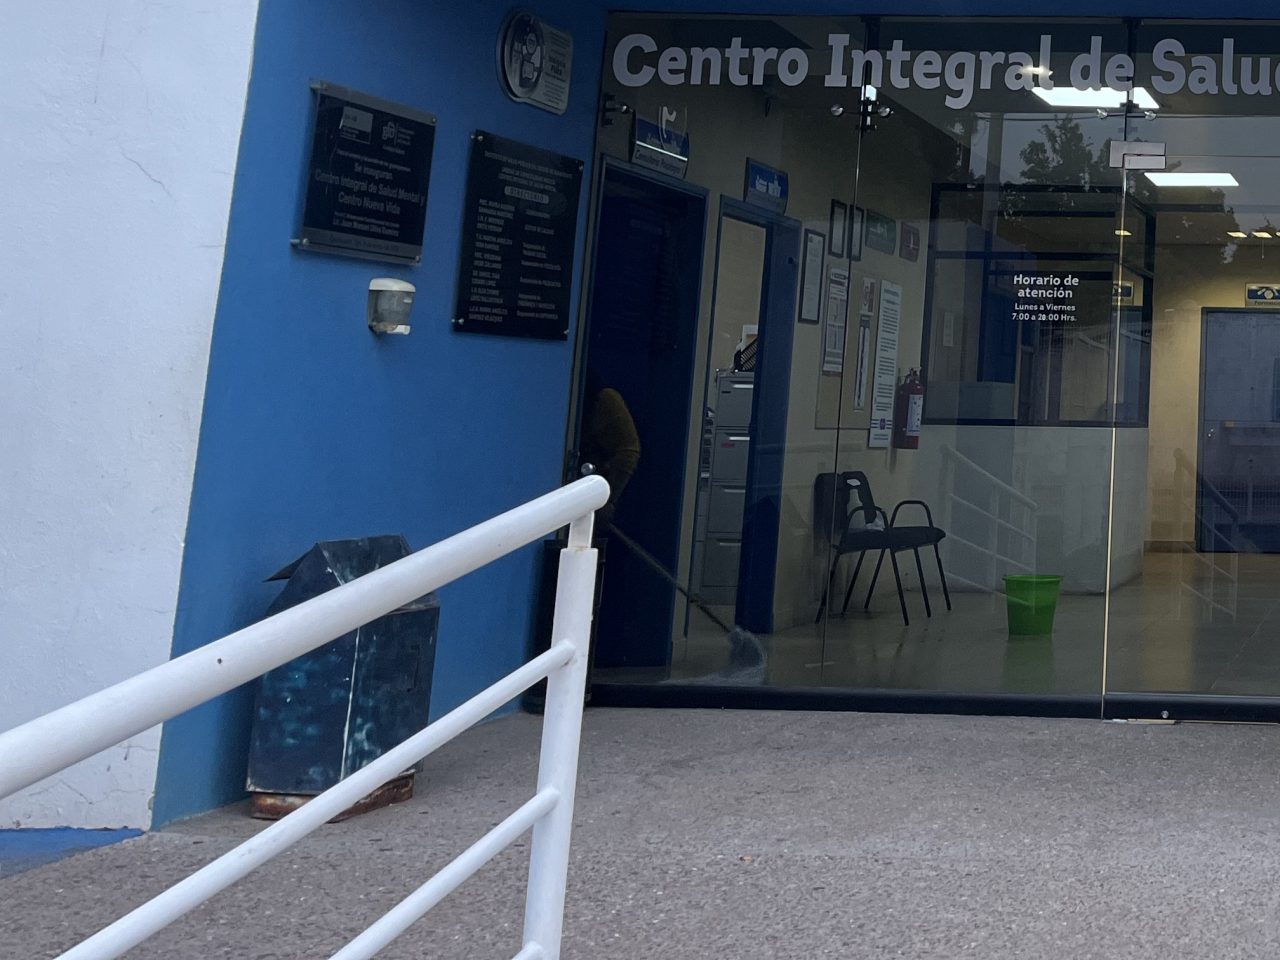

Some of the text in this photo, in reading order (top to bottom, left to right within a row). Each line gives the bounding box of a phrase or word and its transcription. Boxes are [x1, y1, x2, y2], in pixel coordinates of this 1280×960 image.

[612, 33, 809, 87] Centro
[824, 33, 1054, 110] Integral
[1069, 35, 1135, 91] de
[1013, 274, 1080, 286] Horario de
[1018, 287, 1073, 298] atención
[1046, 303, 1076, 311] Viernes
